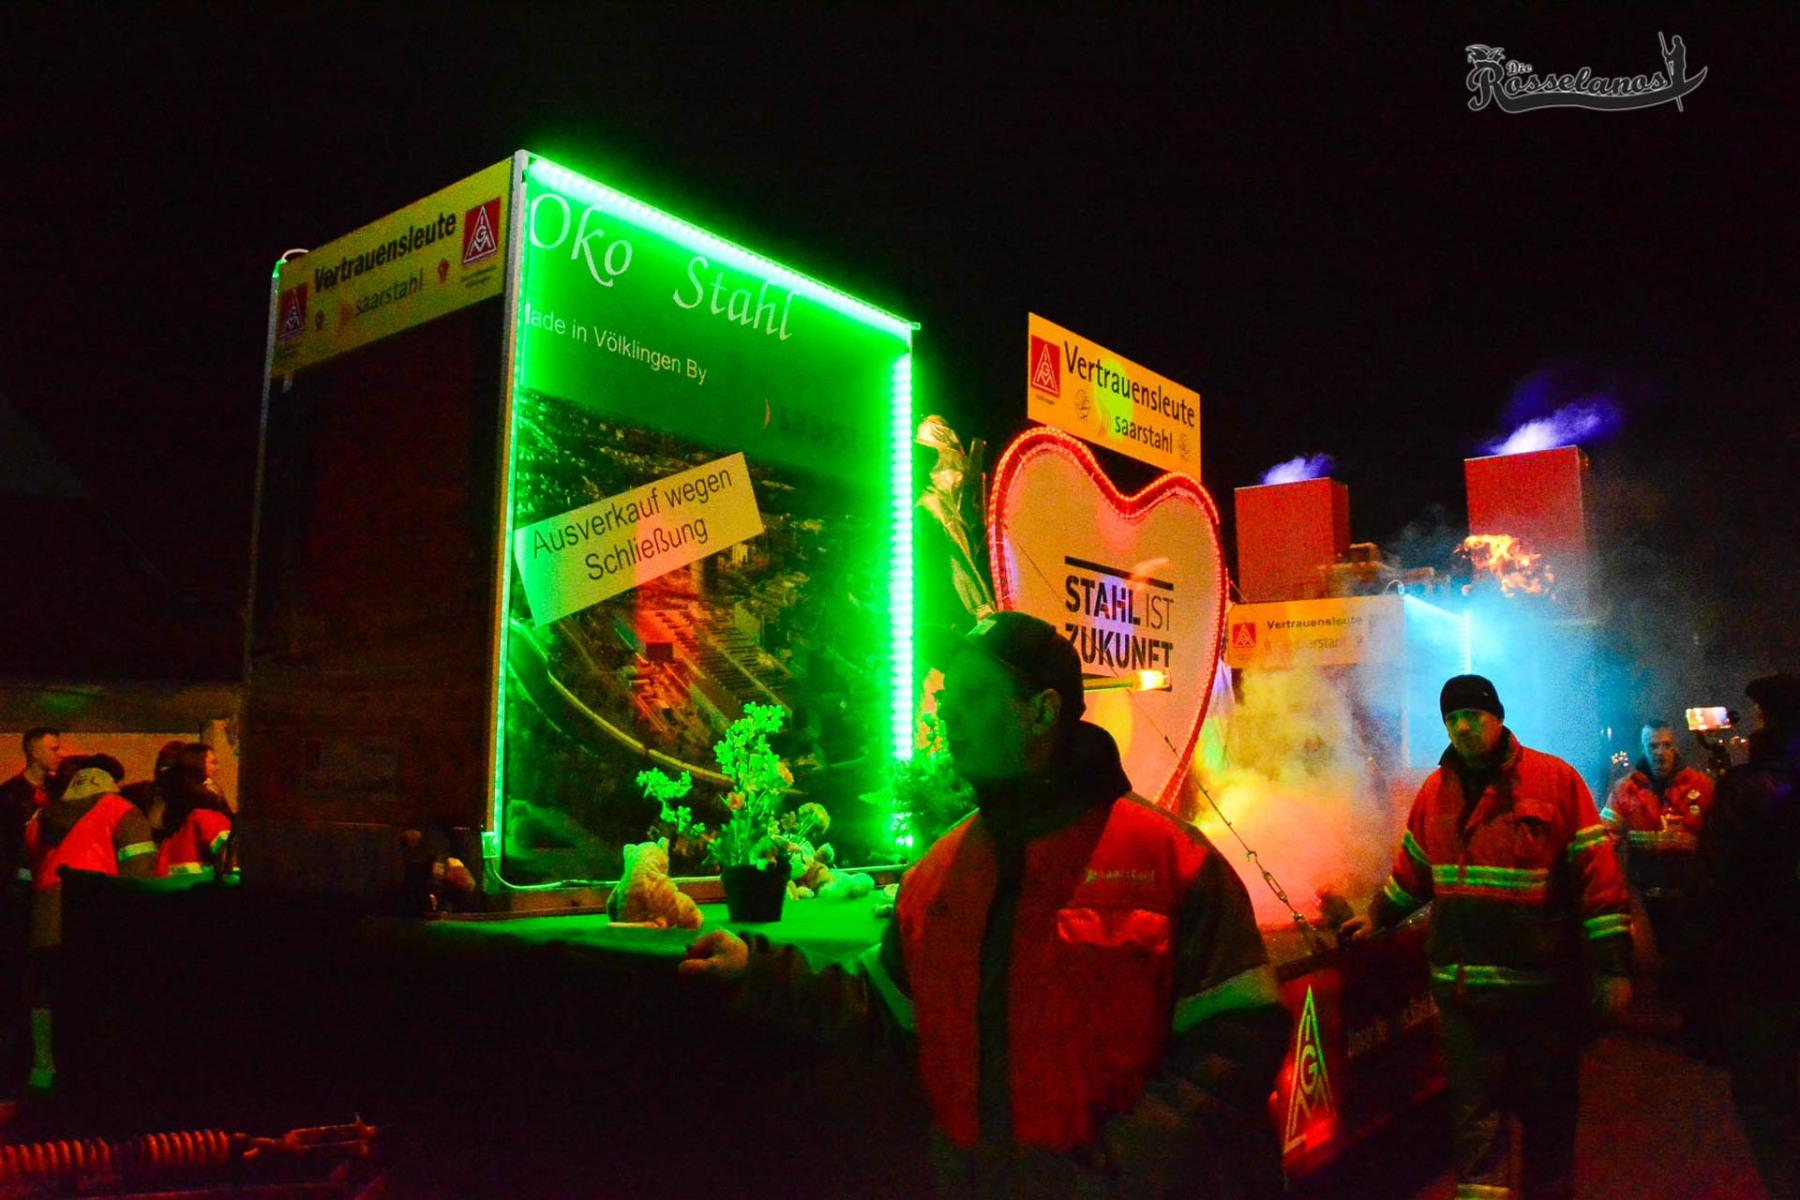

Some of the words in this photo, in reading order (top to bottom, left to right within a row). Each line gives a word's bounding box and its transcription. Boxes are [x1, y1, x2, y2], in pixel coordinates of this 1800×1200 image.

[313, 211, 458, 293] Vertrauensleute
[354, 267, 424, 318] saarstahl
[672, 255, 801, 342] Stahl
[525, 303, 566, 335] ade
[572, 318, 588, 343] in
[593, 325, 682, 375] Völklingen
[686, 357, 708, 386] By
[1063, 340, 1196, 428] Vertrauensleute
[1113, 415, 1174, 455] saarstahl
[533, 487, 661, 559] Ausverkauf
[664, 468, 733, 504] wegen
[584, 517, 709, 581] Schließung
[1064, 574, 1141, 626] STAHL
[1145, 593, 1174, 632] IST
[1064, 622, 1174, 671] ZUKUNFT
